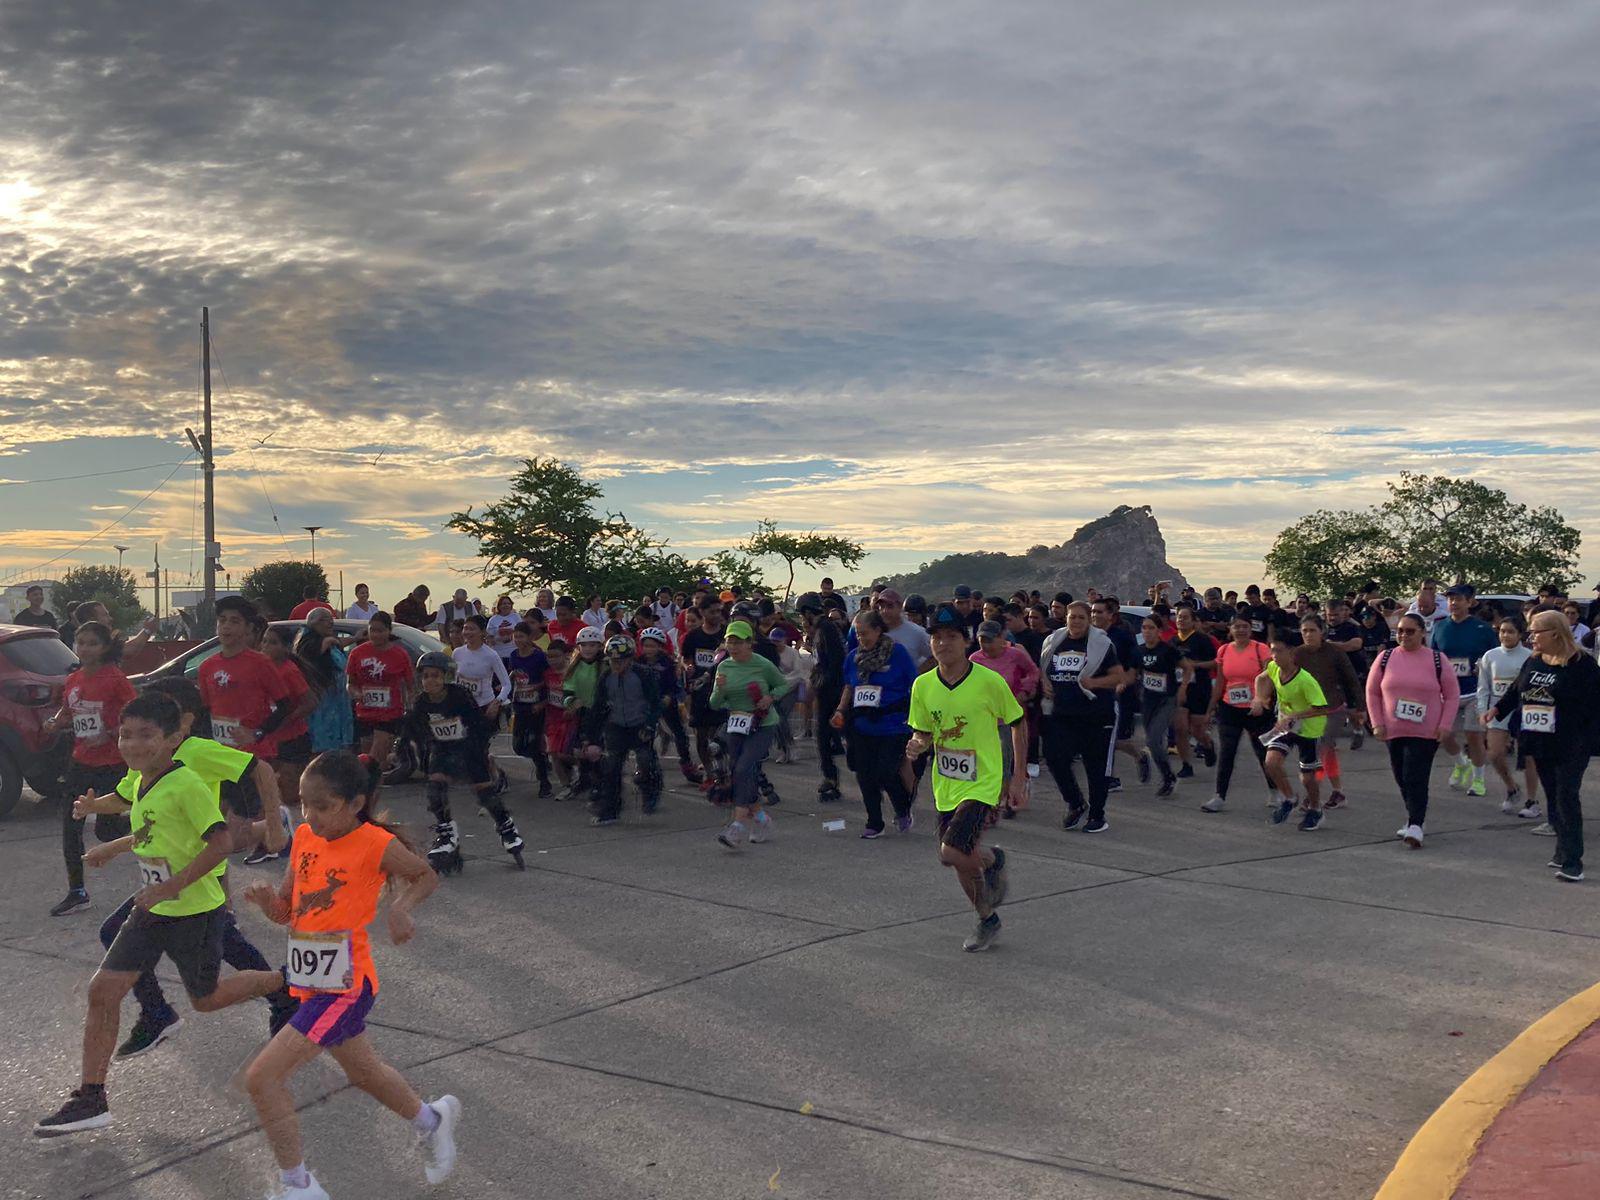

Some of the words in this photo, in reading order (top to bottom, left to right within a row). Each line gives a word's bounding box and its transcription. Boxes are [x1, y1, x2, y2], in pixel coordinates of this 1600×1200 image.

[1060, 656, 1080, 667] 089
[1453, 663, 1466, 672] 76
[1050, 672, 1079, 682] adida
[1146, 677, 1162, 688] 028
[857, 691, 876, 702] 066
[1401, 703, 1423, 717] 156
[75, 717, 98, 731] 082
[1525, 712, 1548, 726] 095
[434, 724, 458, 737] 007
[941, 755, 969, 774] 096
[291, 947, 339, 976] 097
